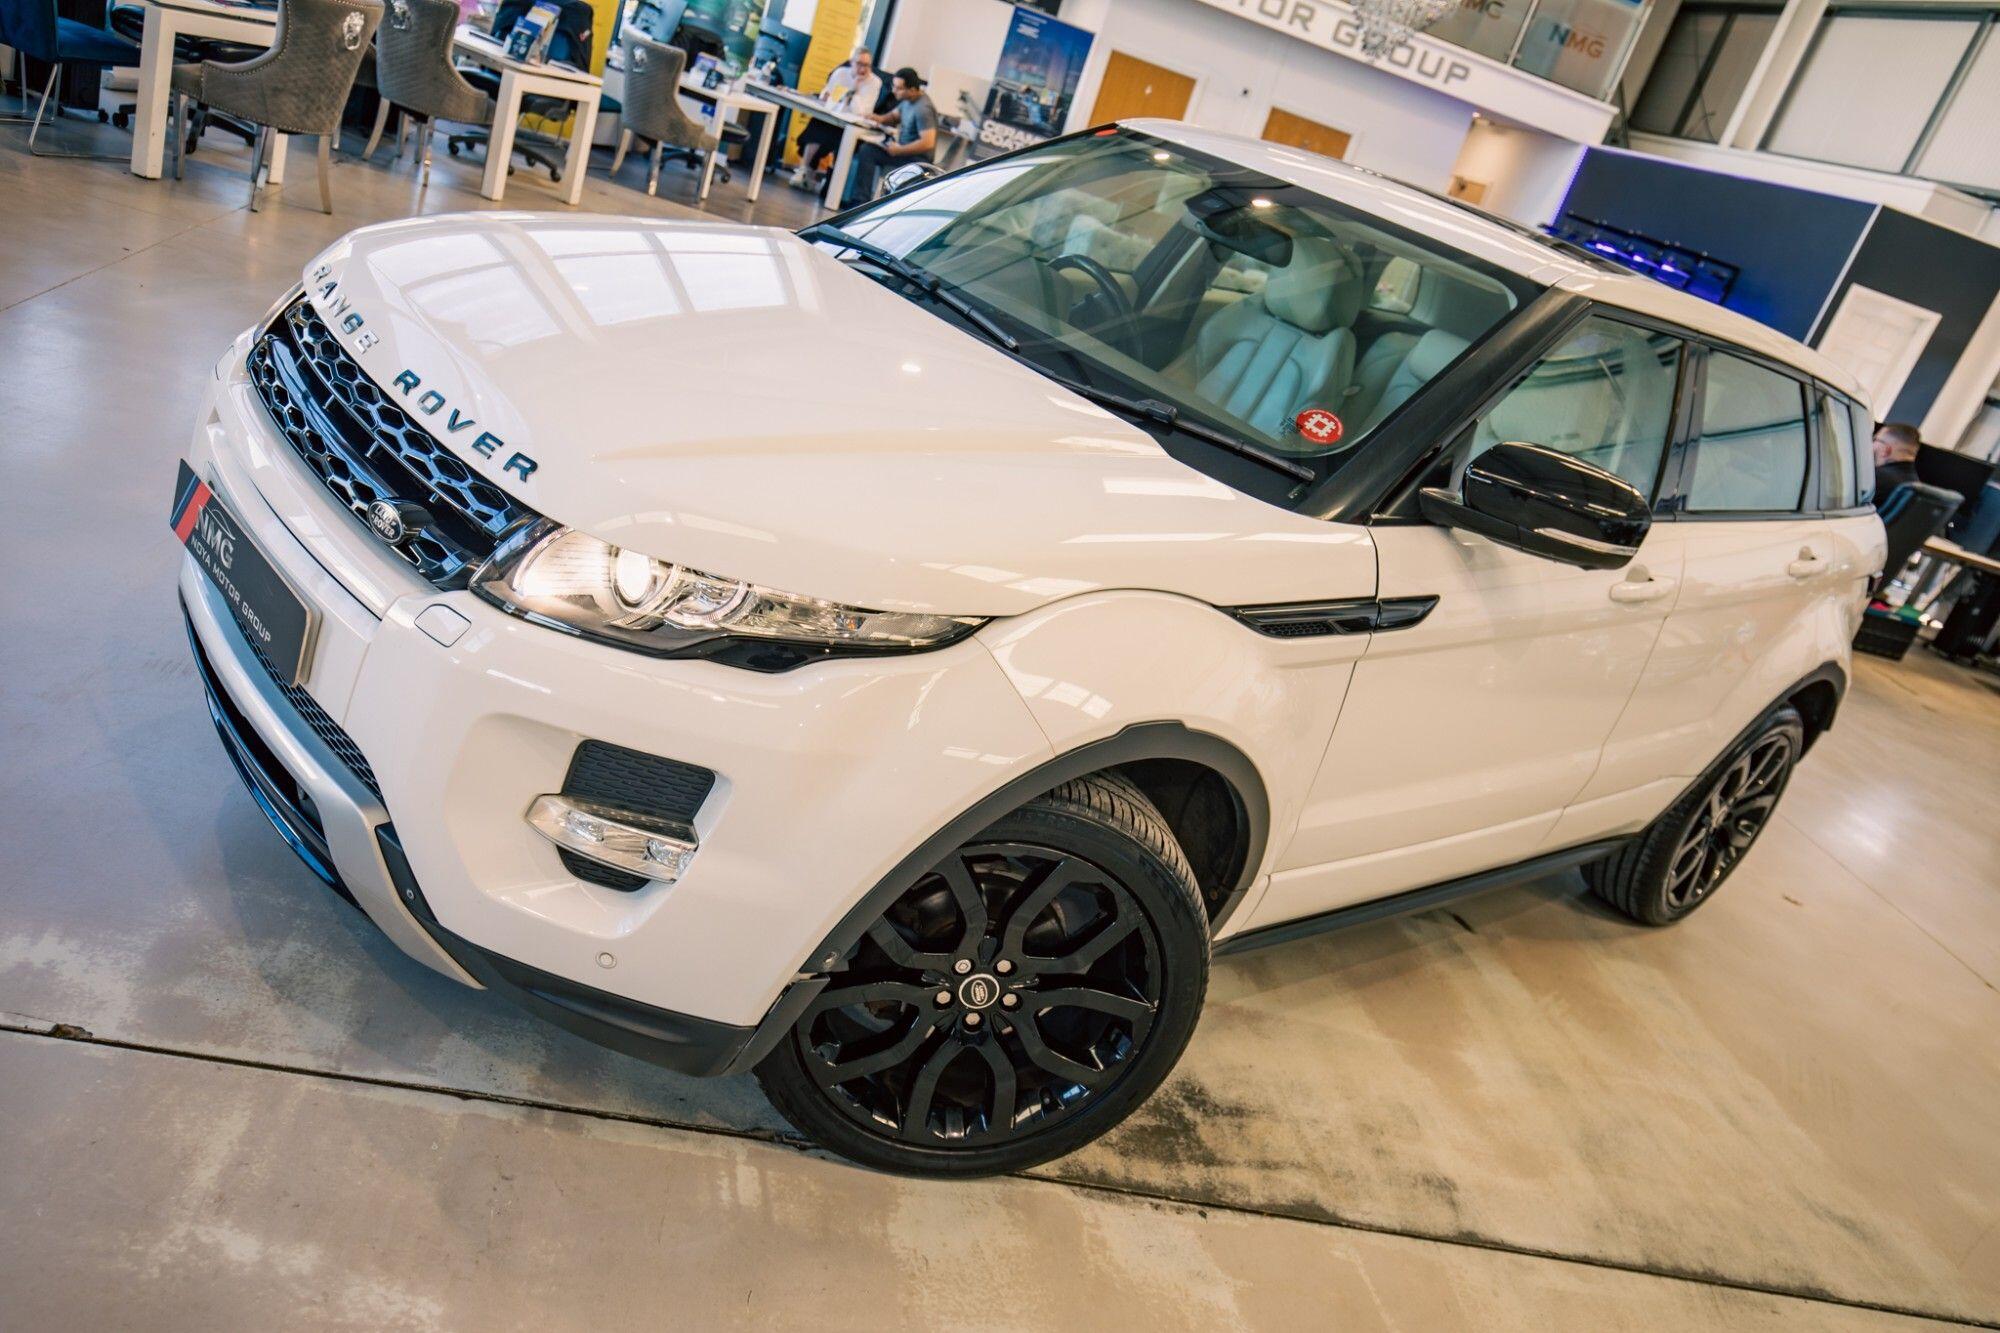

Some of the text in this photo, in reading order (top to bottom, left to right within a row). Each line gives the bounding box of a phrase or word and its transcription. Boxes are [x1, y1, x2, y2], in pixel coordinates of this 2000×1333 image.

[1332, 18, 1471, 84] GOUP
[1548, 24, 1605, 59] NMG
[313, 263, 538, 483] RANGE ROVER
[196, 505, 234, 569] NMG
[191, 535, 272, 643] NOYA MOTOR GROUP
